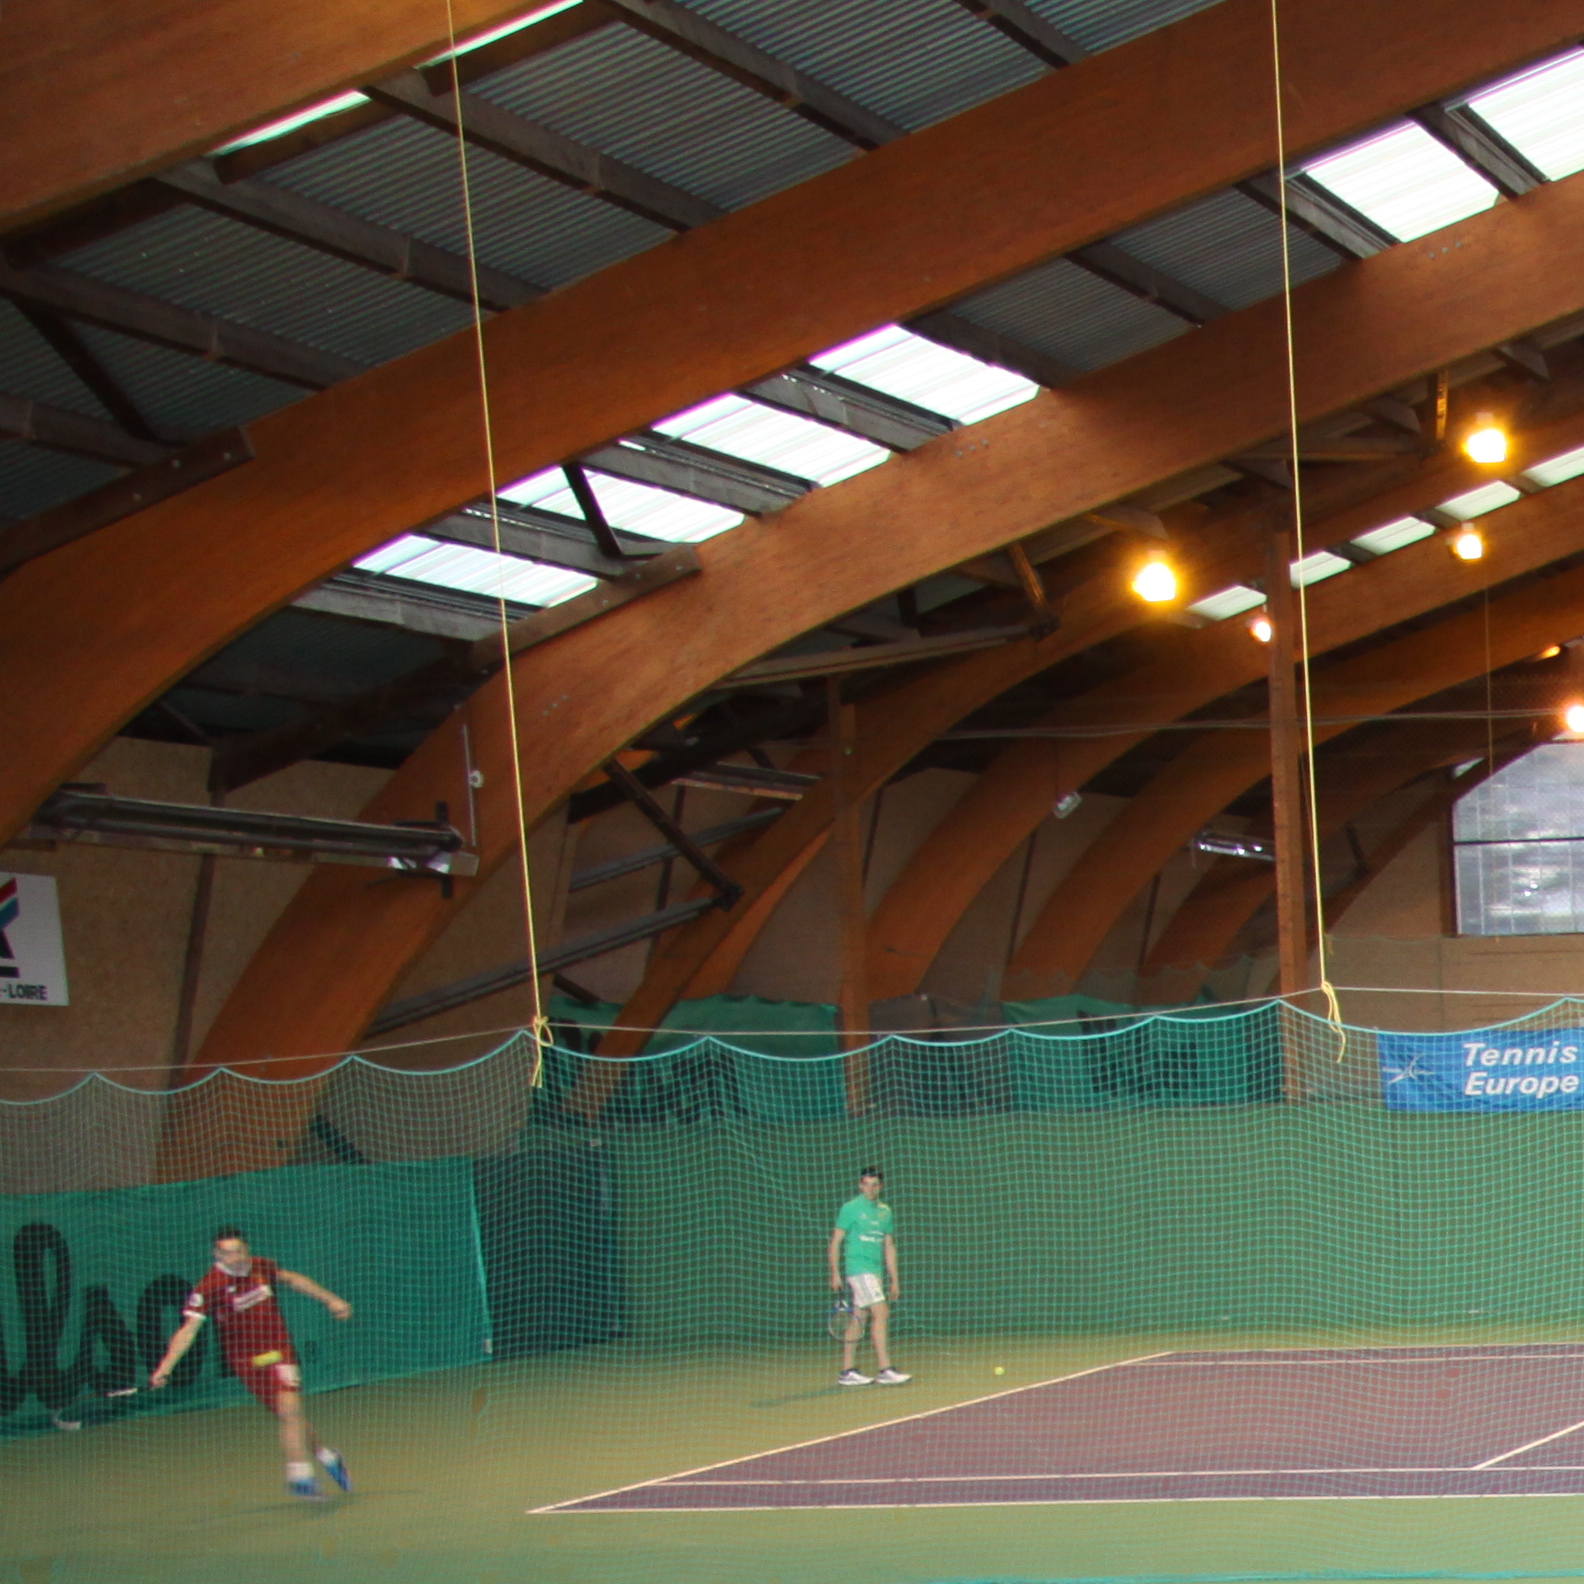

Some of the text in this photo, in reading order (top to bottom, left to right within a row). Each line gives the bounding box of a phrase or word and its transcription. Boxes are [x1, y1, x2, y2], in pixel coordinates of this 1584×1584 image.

[0, 983, 48, 1001] -LOIRE
[1463, 1041, 1578, 1067] Tennis
[1464, 1072, 1579, 1099] Europe
[0, 1222, 234, 1411] lso
